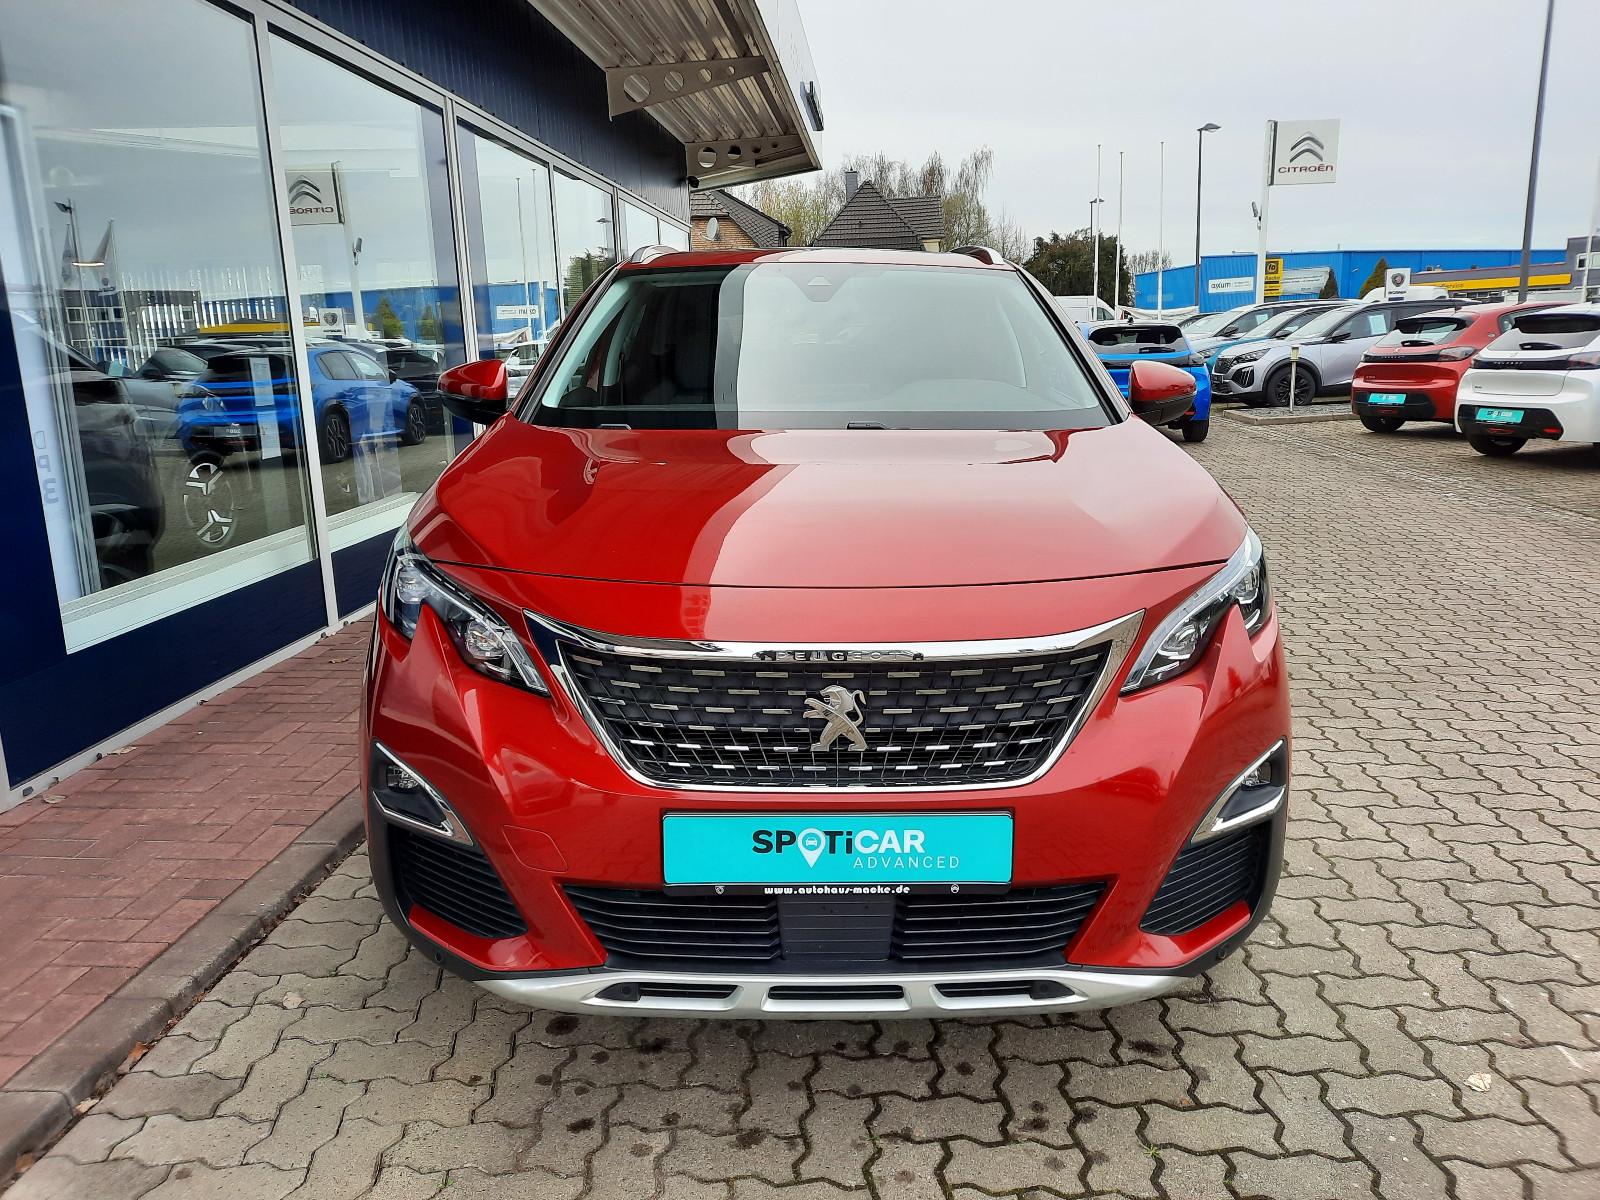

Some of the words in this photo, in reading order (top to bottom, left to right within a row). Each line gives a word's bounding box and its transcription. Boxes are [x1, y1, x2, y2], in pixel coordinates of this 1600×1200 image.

[775, 649, 901, 661] PEUGEOT
[853, 856, 959, 869] ADVANCED
[764, 885, 911, 895] www.autohaus-macke.de
